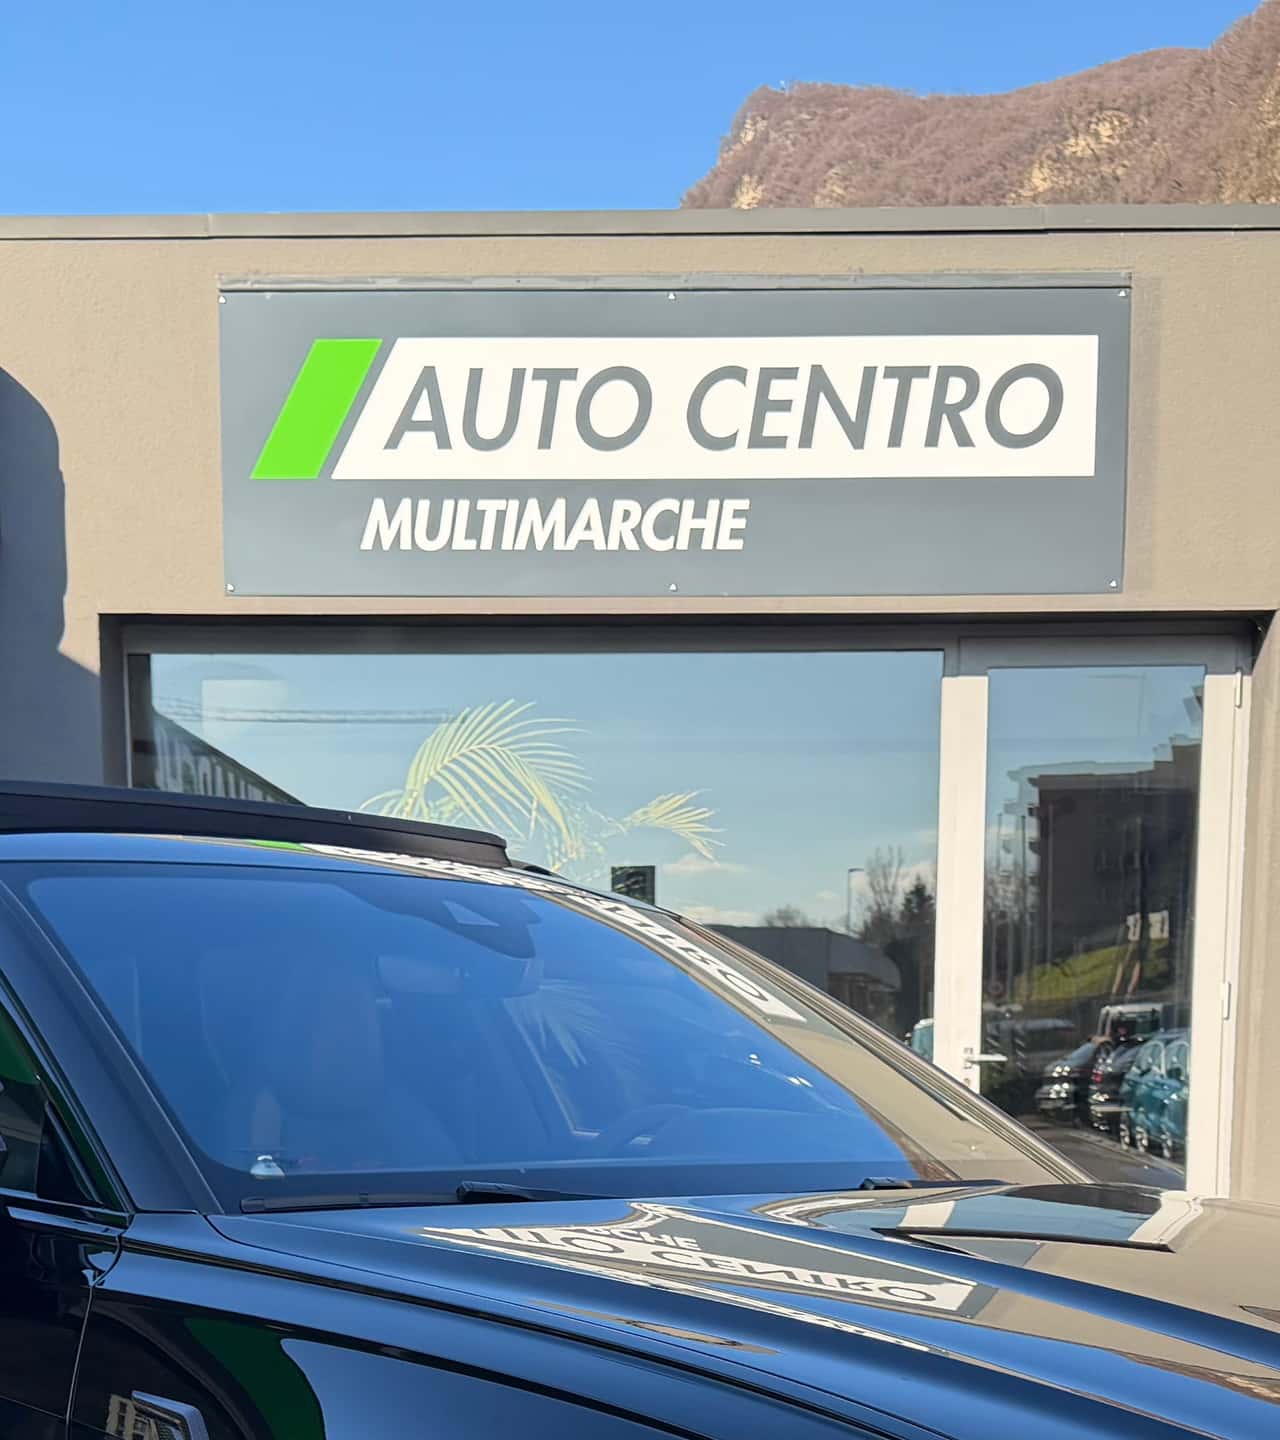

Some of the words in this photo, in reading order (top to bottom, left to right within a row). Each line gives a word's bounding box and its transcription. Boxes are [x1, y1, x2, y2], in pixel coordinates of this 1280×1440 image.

[382, 365, 653, 453] AUTO
[686, 363, 1065, 452] CENTRO
[360, 497, 751, 553] MULTIMARCHE
